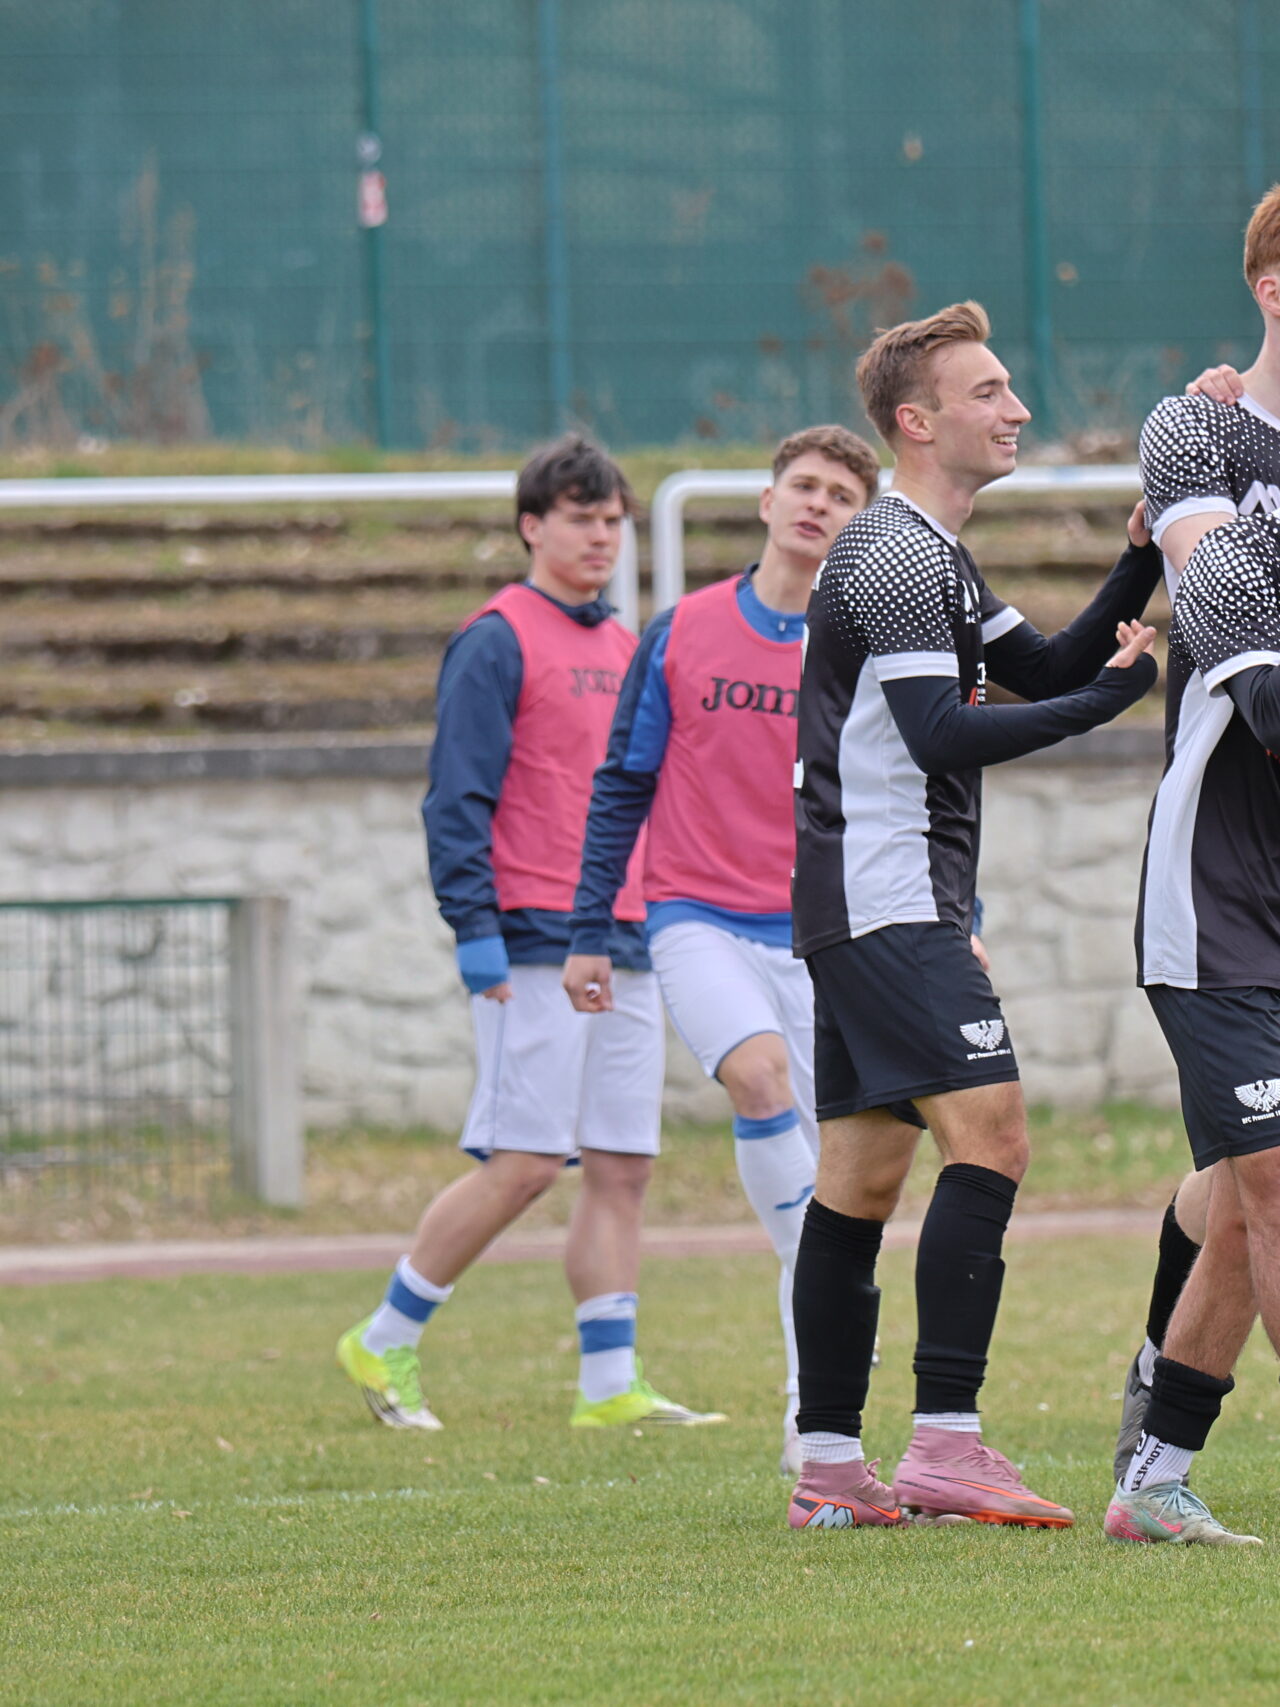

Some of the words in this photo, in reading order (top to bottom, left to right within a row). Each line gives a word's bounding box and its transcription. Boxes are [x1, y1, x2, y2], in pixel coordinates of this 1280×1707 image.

[568, 669, 620, 698] JOM
[702, 677, 800, 717] JOM
[1140, 1441, 1166, 1471] FOOT
